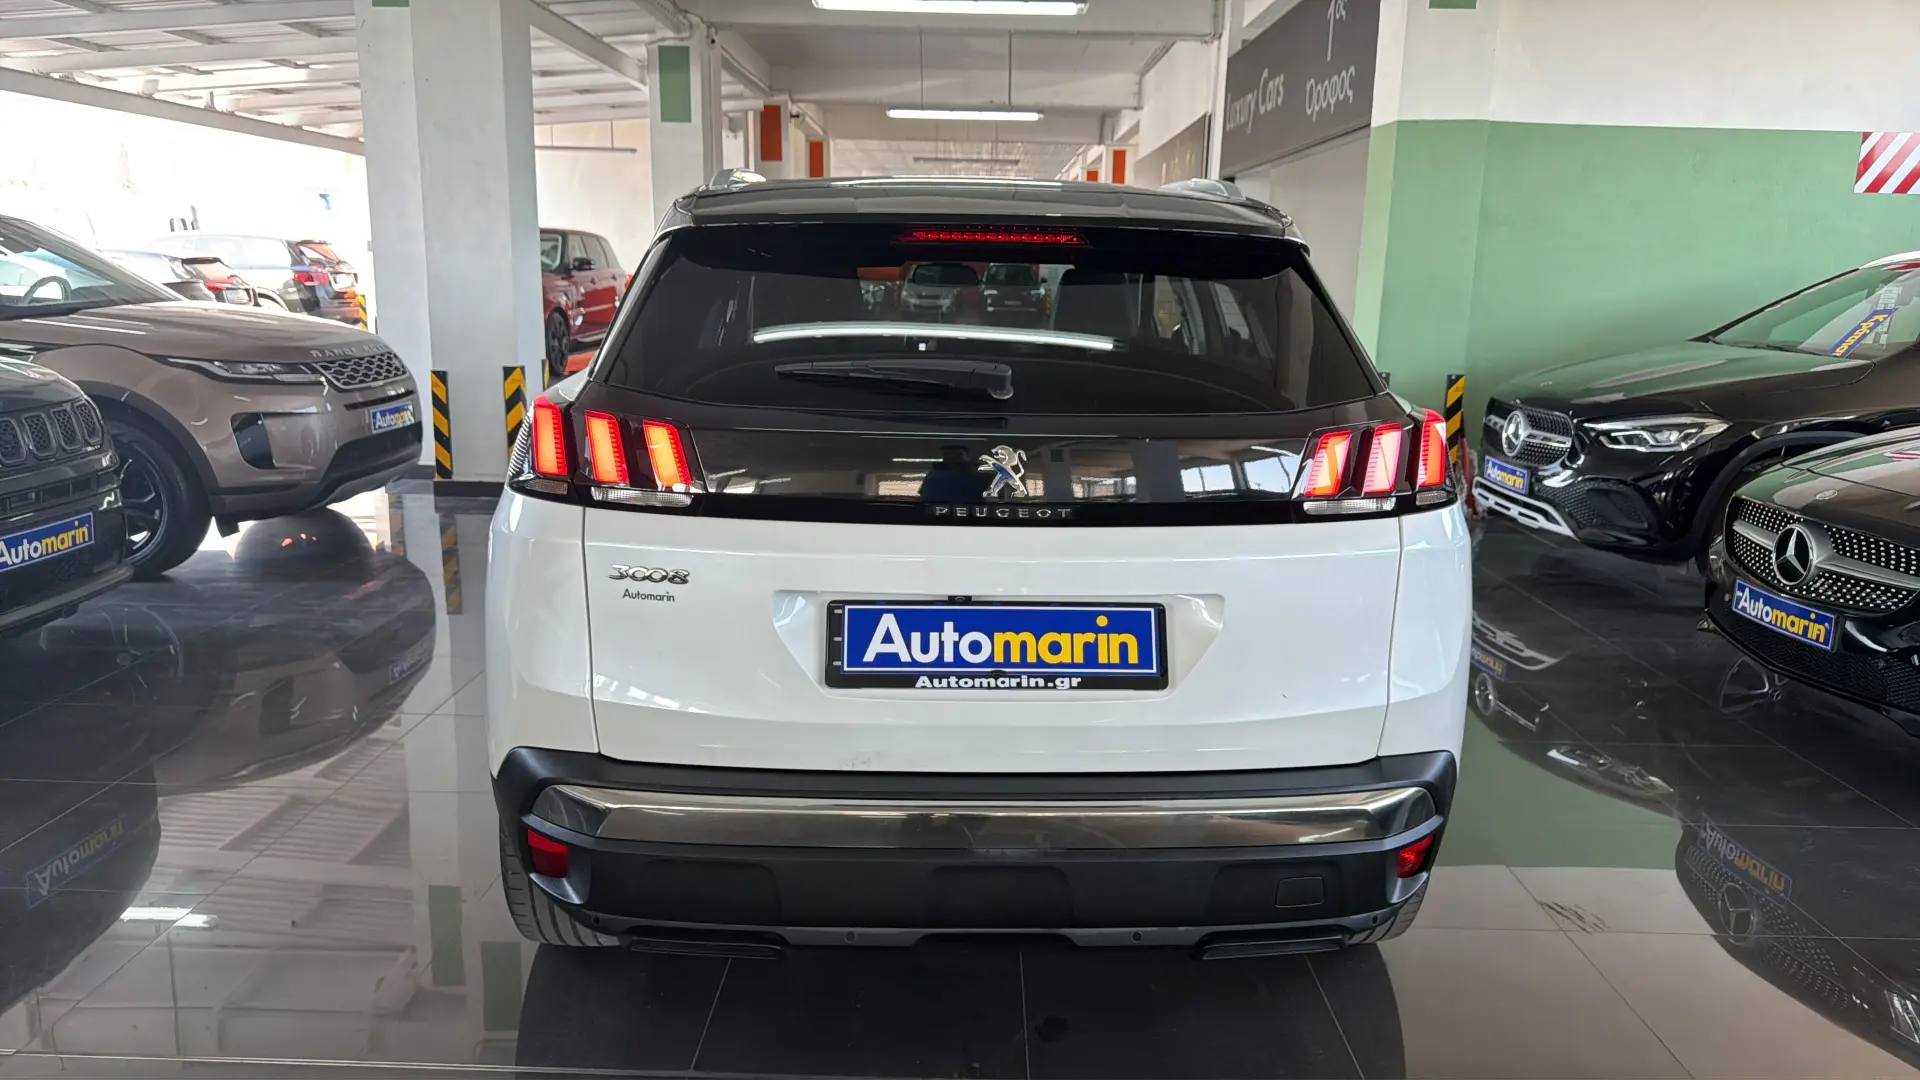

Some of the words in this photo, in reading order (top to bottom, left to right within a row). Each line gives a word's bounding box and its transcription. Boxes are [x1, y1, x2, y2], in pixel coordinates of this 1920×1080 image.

[1226, 88, 1257, 134] Luxury
[1258, 68, 1285, 115] Cars
[935, 506, 1071, 518] PEUGEOT
[608, 564, 691, 585] 3008
[622, 588, 676, 602] Automarin
[1737, 587, 1827, 644] Automarin
[862, 613, 1139, 665] Automarin
[914, 675, 1082, 690] Automarin.gr
